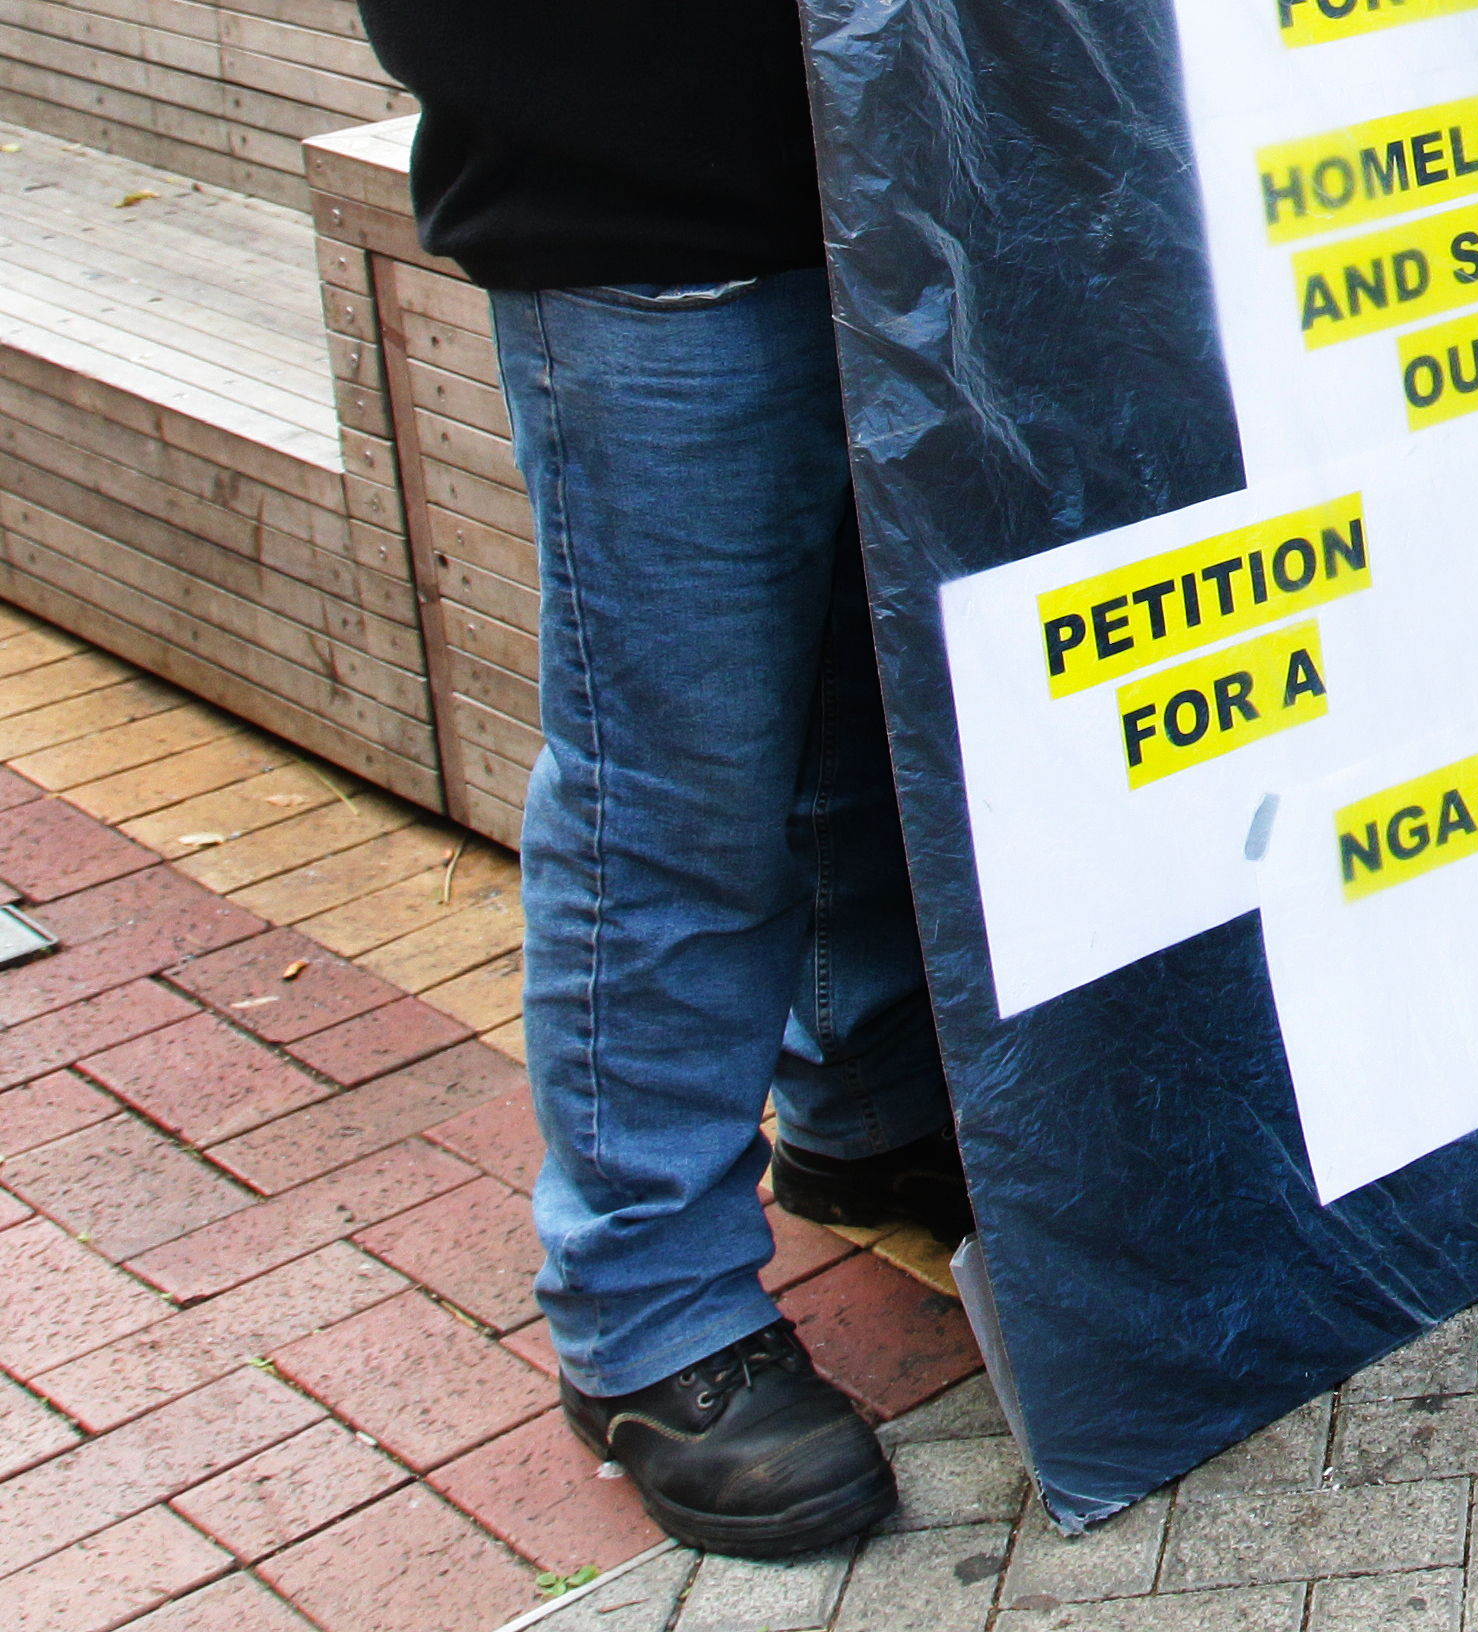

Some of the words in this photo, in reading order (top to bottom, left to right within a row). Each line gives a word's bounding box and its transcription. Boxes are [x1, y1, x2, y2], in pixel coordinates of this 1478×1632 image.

[1301, 248, 1429, 330] AND
[1043, 518, 1366, 676] PETITION
[1121, 671, 1260, 768] FOR
[1283, 649, 1327, 708] A
[1339, 789, 1478, 882] NGA
